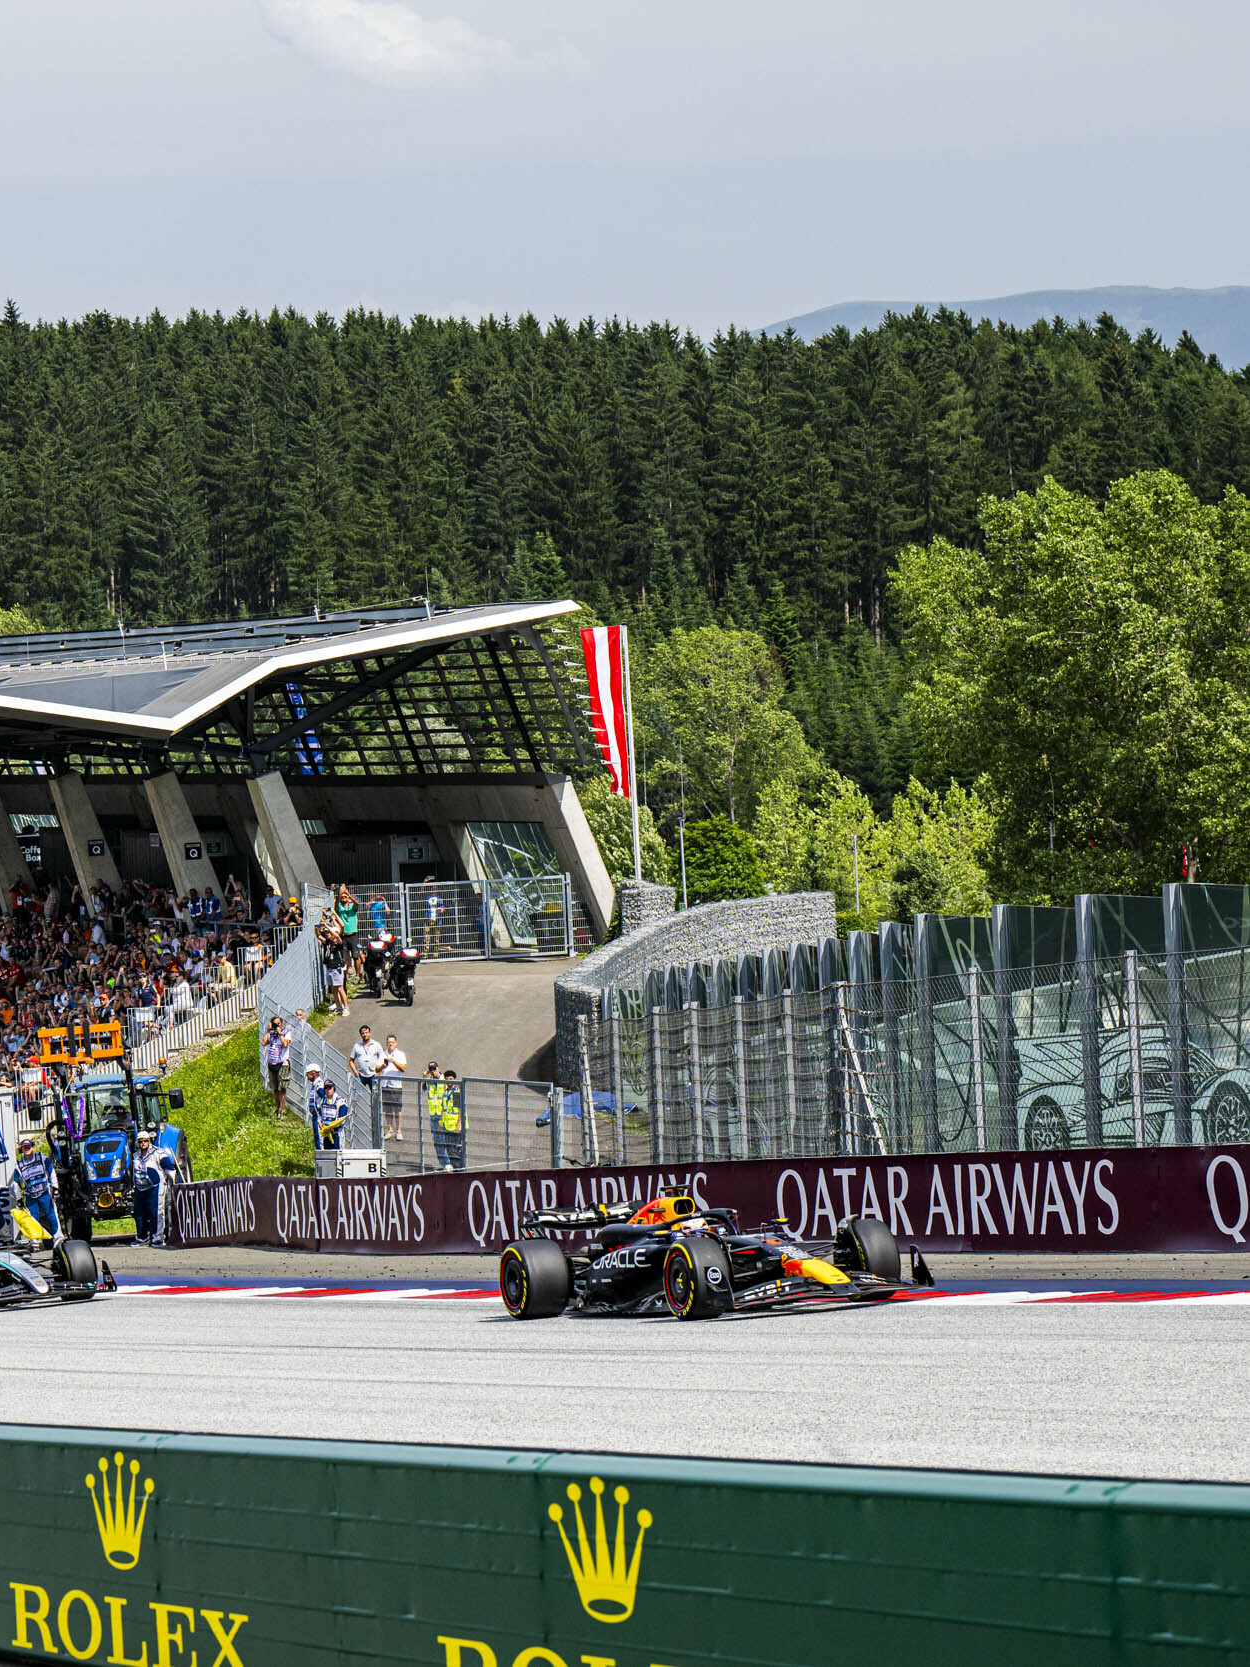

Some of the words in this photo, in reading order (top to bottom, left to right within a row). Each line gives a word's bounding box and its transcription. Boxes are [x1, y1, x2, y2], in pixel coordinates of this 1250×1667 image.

[367, 1163, 377, 1173] B
[776, 1165, 915, 1241] QATAR
[925, 1158, 1120, 1236] AIRWAYS
[175, 1188, 210, 1243] QATAR
[210, 1180, 256, 1238] AIRWAYS
[276, 1183, 332, 1244] QATAR
[335, 1183, 425, 1242] AIRWAYS
[467, 1178, 564, 1248] QATAR
[592, 1248, 652, 1270] ORACLE
[9, 1581, 249, 1667] ROLEX
